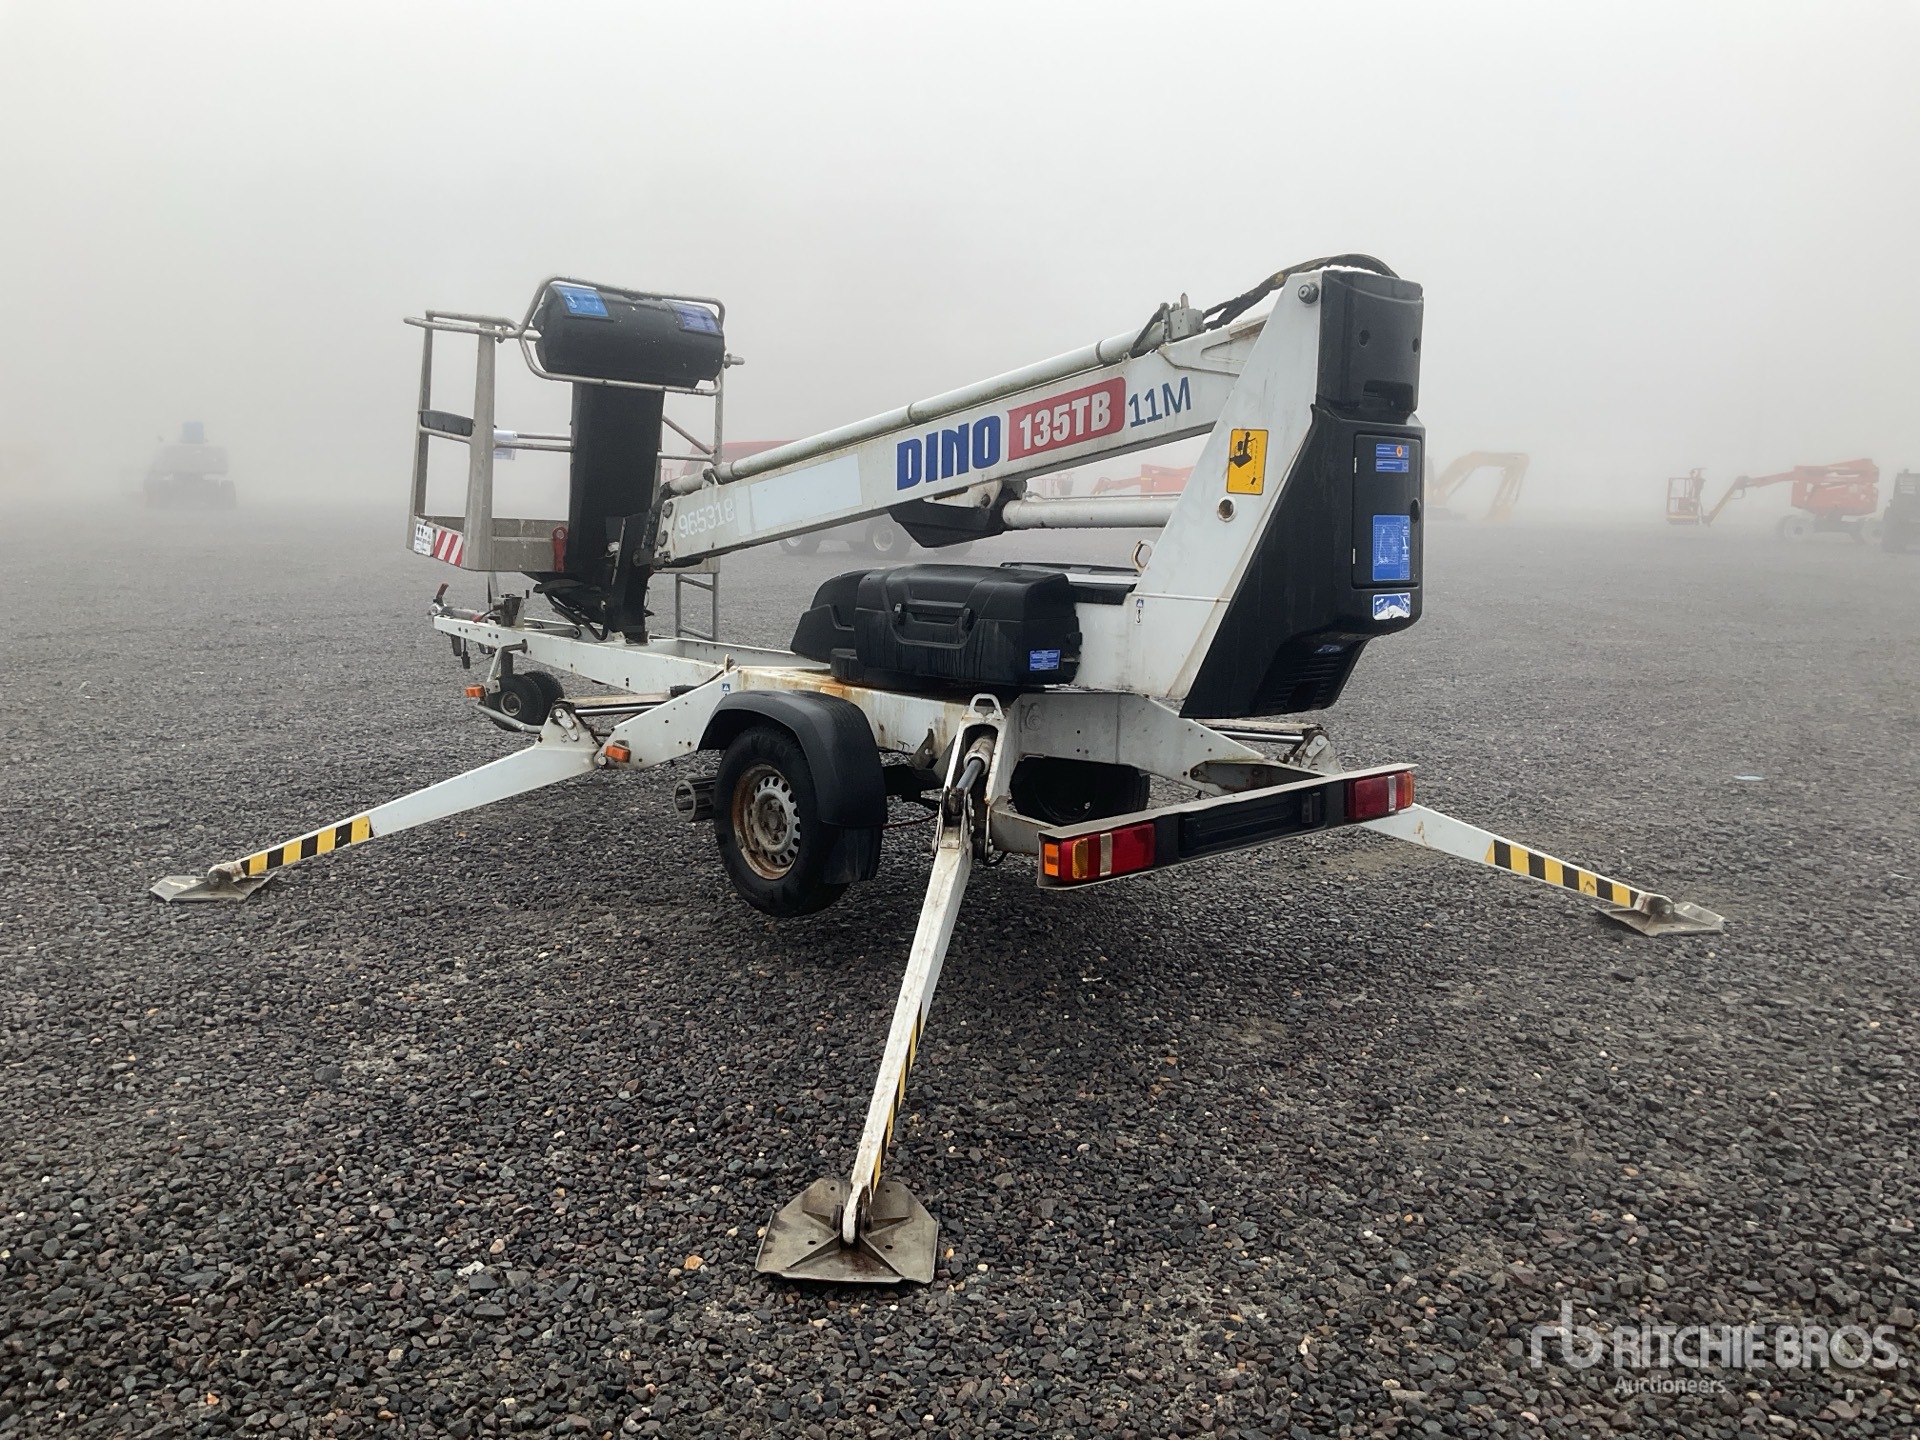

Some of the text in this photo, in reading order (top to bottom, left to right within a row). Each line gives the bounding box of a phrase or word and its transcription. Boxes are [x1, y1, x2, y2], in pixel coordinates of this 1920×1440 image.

[897, 376, 1192, 491] DINO 135TB 11M
[679, 499, 735, 538] 965318
